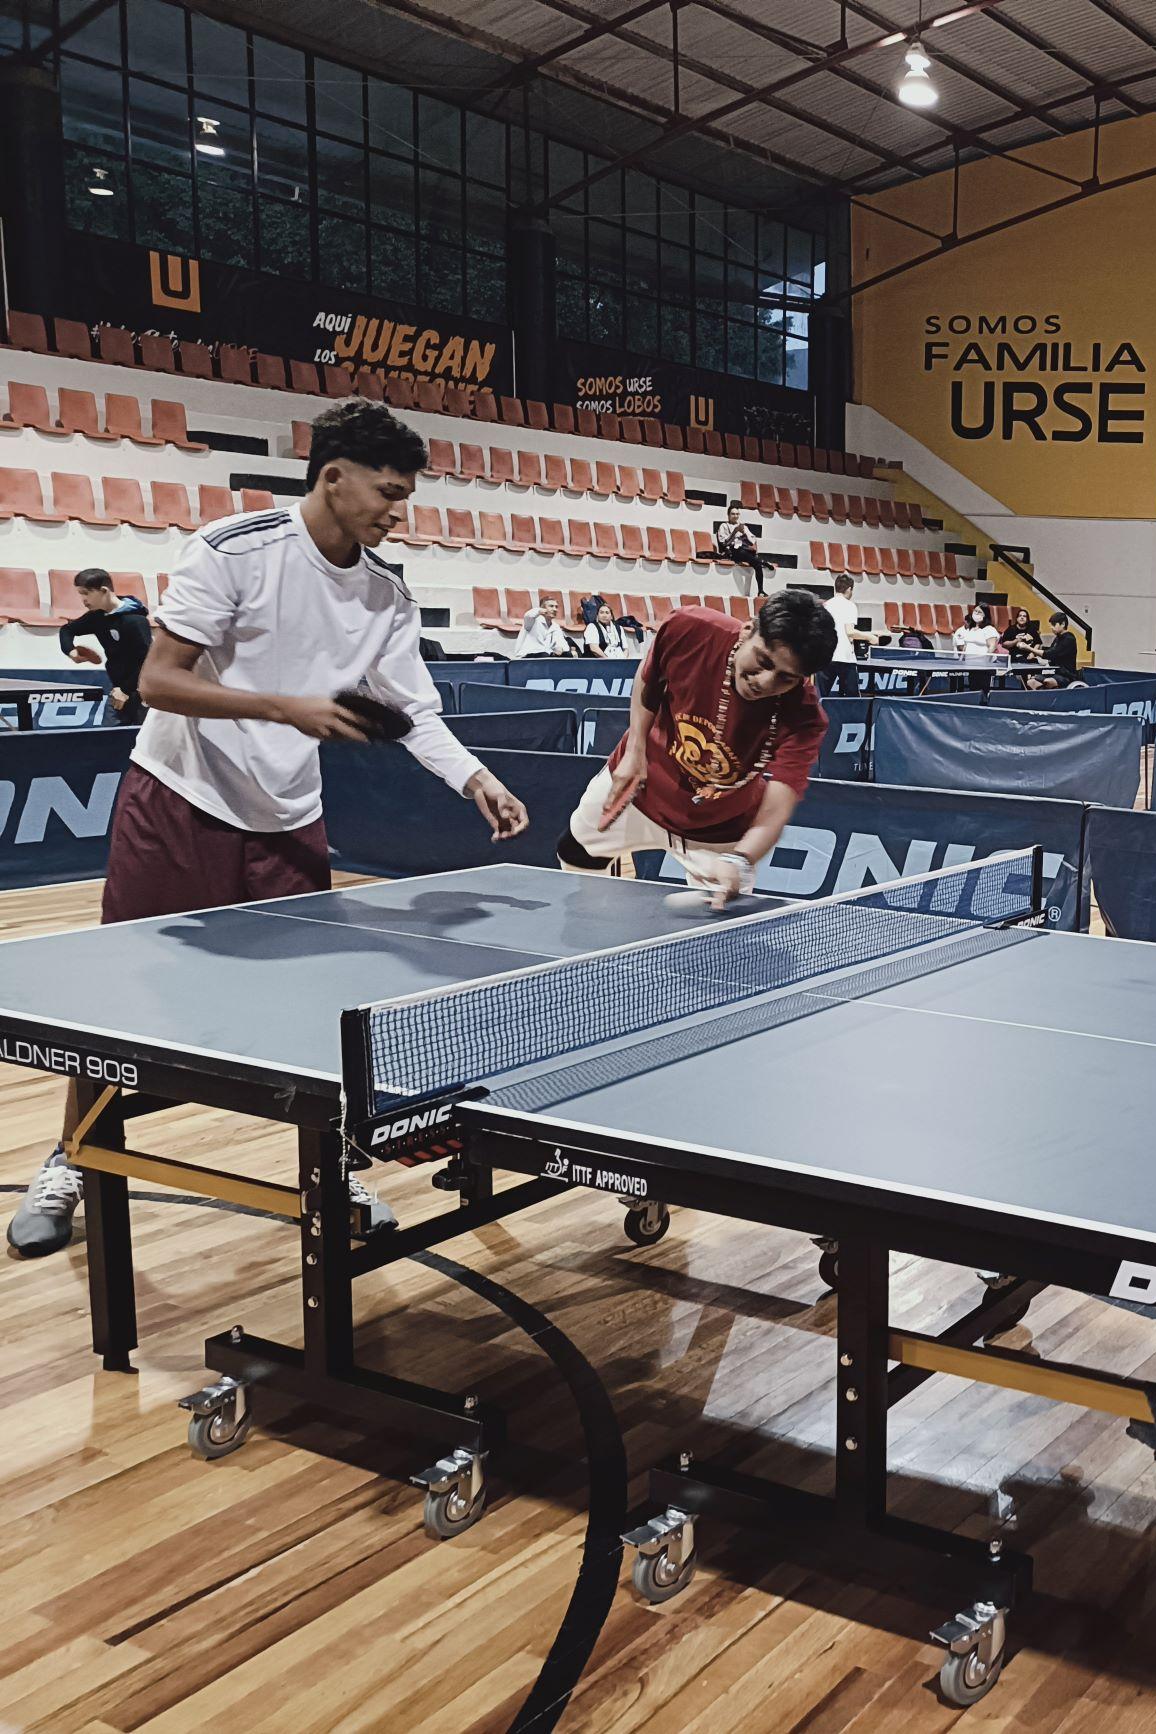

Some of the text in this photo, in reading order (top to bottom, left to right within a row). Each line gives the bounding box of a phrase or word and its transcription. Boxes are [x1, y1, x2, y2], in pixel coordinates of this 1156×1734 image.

[924, 315, 1062, 335] SOMOS
[314, 348, 337, 365] LOS
[334, 315, 496, 382] JUEGAN
[924, 342, 1147, 372] FAMILIA
[576, 376, 653, 396] SOMOS URSE
[616, 395, 661, 414] LOBOS
[951, 381, 1146, 443] URSE
[28, 692, 84, 703] DONIC
[86, 1055, 138, 1086] 909
[370, 1104, 453, 1146] DONIC
[572, 1164, 648, 1196] ITTF APPROVED
